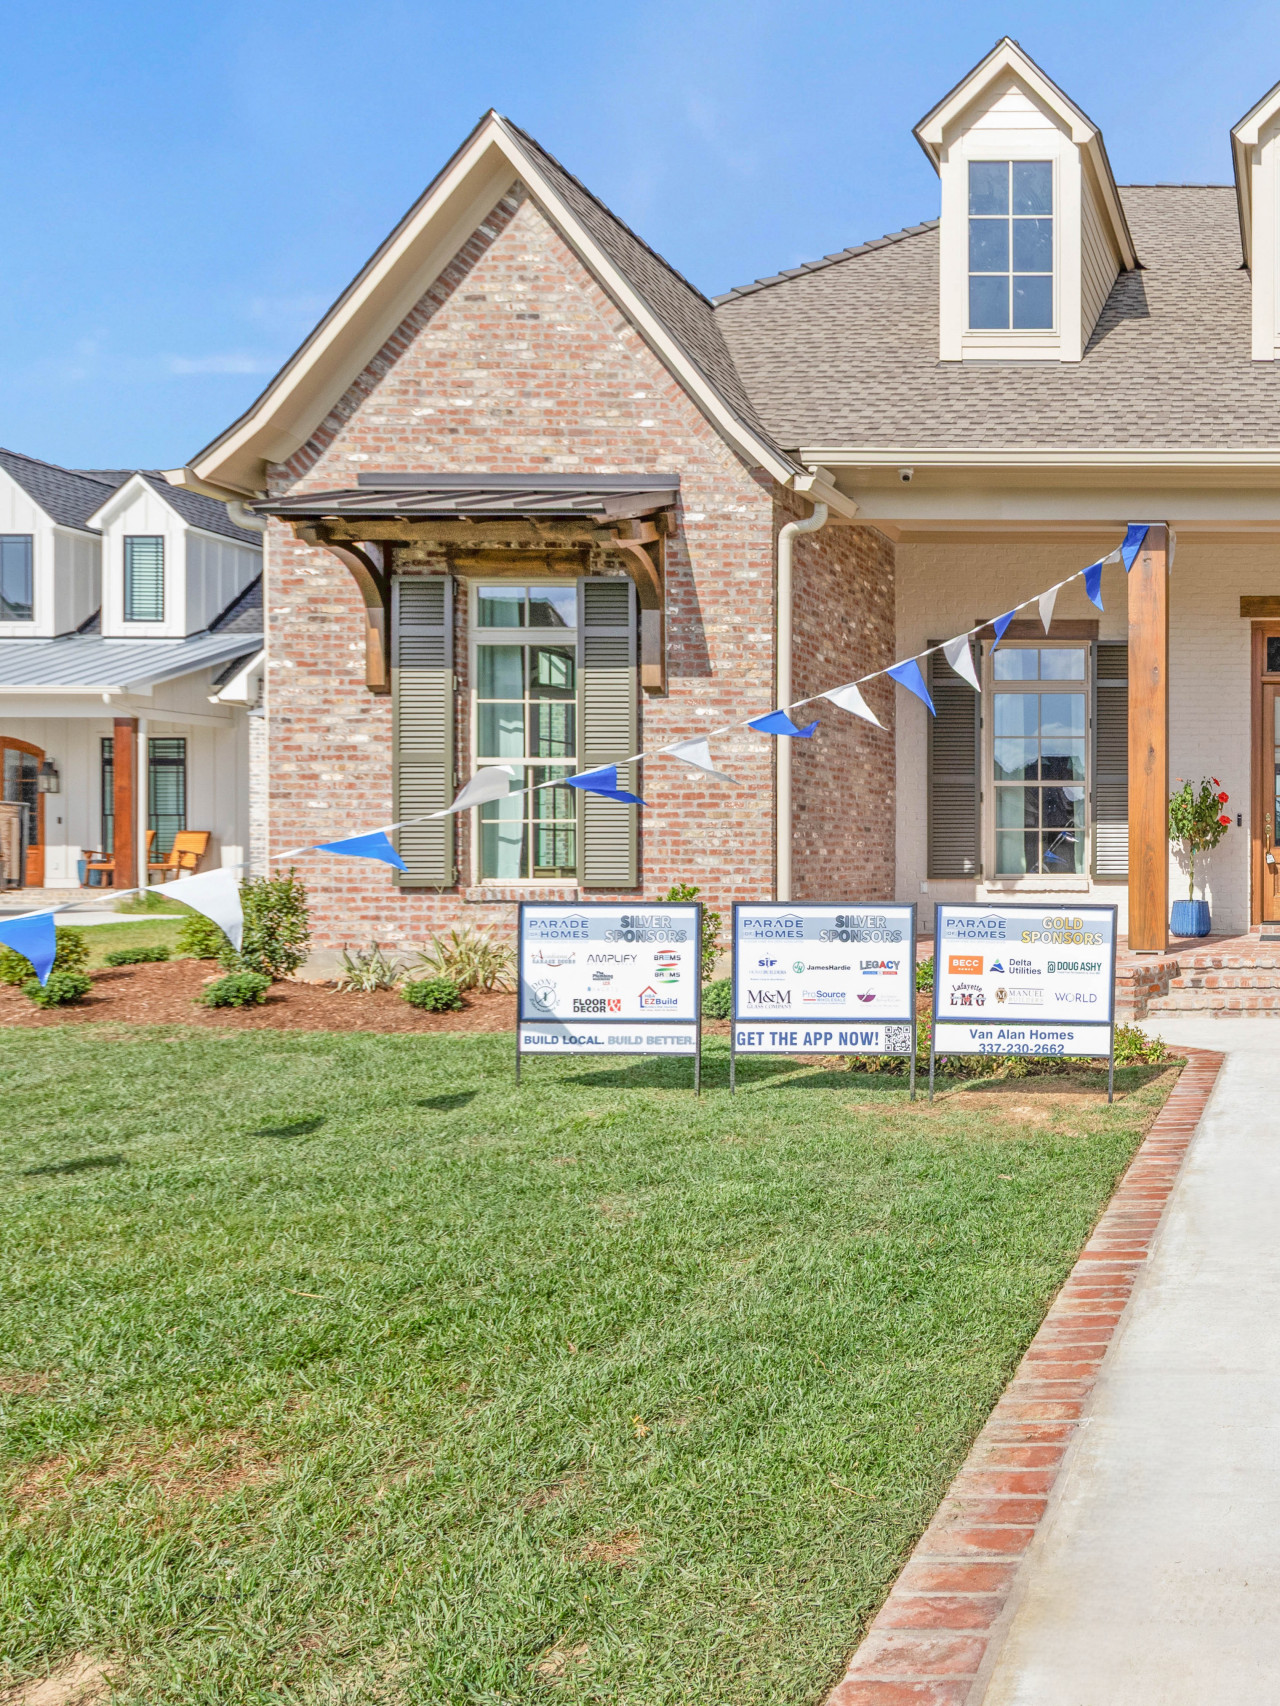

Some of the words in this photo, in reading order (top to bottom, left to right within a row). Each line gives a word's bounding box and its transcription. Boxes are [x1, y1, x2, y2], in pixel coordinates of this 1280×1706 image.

[621, 915, 671, 928] SILVER
[744, 920, 803, 928] PARADE
[835, 915, 886, 928] SILVER
[947, 920, 1006, 928] PARADE
[1042, 917, 1083, 930] GOLD
[604, 930, 687, 943] SPONSORS
[819, 930, 902, 943] SPONSORS
[1021, 931, 1103, 945] SPONSORS
[587, 954, 637, 962] AMPLIFY
[953, 959, 979, 967] BECC
[860, 960, 900, 970] LEGACY
[1057, 962, 1078, 971] DOUG
[1080, 963, 1102, 972] ASHY
[1009, 966, 1041, 975] Utilities
[952, 982, 983, 992] Lafayette
[747, 990, 791, 1004] M&M
[802, 990, 846, 998] ProSource
[1055, 993, 1097, 1003] WORLD
[737, 1032, 764, 1046] GET
[770, 1032, 797, 1046] THE
[803, 1032, 833, 1046] APP
[839, 1032, 879, 1046] NOW!
[970, 1029, 992, 1040] Van
[997, 1029, 1025, 1040] Alan
[1030, 1030, 1074, 1040] Homes
[524, 1036, 559, 1044] BUILD
[563, 1036, 604, 1045] LOCAL.
[608, 1036, 642, 1045] BUILD
[647, 1036, 696, 1045] BETTER.
[979, 1043, 1064, 1054] 337-230-2662
